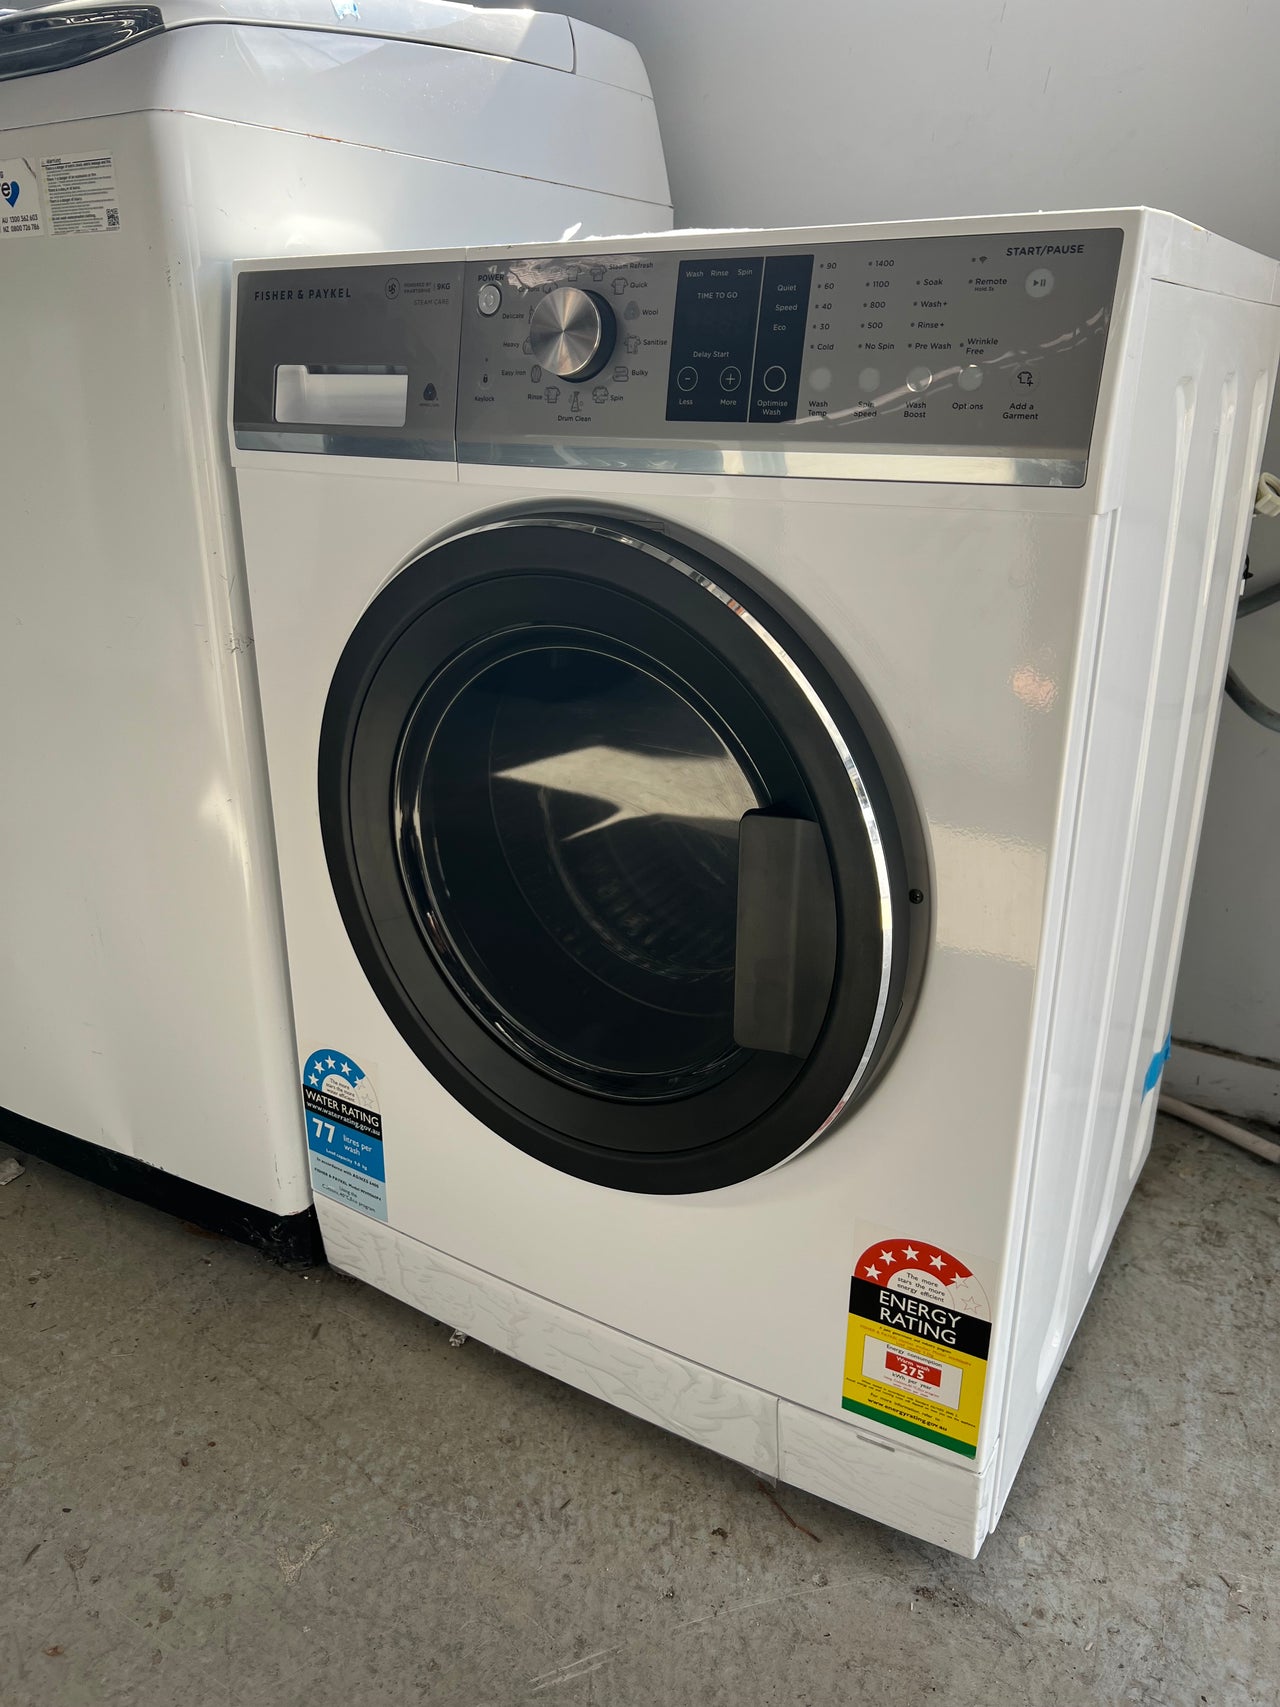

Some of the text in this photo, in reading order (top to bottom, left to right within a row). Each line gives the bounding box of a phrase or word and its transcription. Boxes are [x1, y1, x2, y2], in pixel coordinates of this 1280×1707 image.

[1006, 244, 1085, 257] START/PAUSE
[711, 269, 729, 277] Rinse
[254, 288, 351, 301] FISHER & PAYKEL
[777, 284, 797, 292] Quiet
[775, 304, 798, 312] Speed
[930, 342, 951, 350] Wash
[967, 338, 999, 346] Wrinkle
[693, 351, 712, 359] Delay
[632, 369, 648, 377] Bulky
[527, 393, 543, 401] Rinse
[808, 400, 828, 408] Wash
[808, 409, 827, 417] Temp
[1002, 412, 1038, 420] Garment
[305, 1089, 379, 1127] WATER RATING
[307, 1102, 380, 1135] www.waterrating.gov.au
[313, 1117, 335, 1143] 77
[343, 1134, 373, 1152] litres per
[344, 1145, 360, 1156] wash
[907, 1272, 938, 1287] The more
[897, 1277, 912, 1285] stars
[929, 1288, 945, 1296] more
[897, 1283, 944, 1302] energy efficient
[879, 1289, 962, 1328] ENERGY
[879, 1309, 956, 1345] RATING
[886, 1344, 904, 1354] Energy
[908, 1352, 942, 1368] consumption
[896, 1356, 930, 1372] Warm wash
[892, 1372, 905, 1381] kWh
[900, 1364, 925, 1380] 275
[868, 1398, 947, 1431] www.energyrating.gov.au
